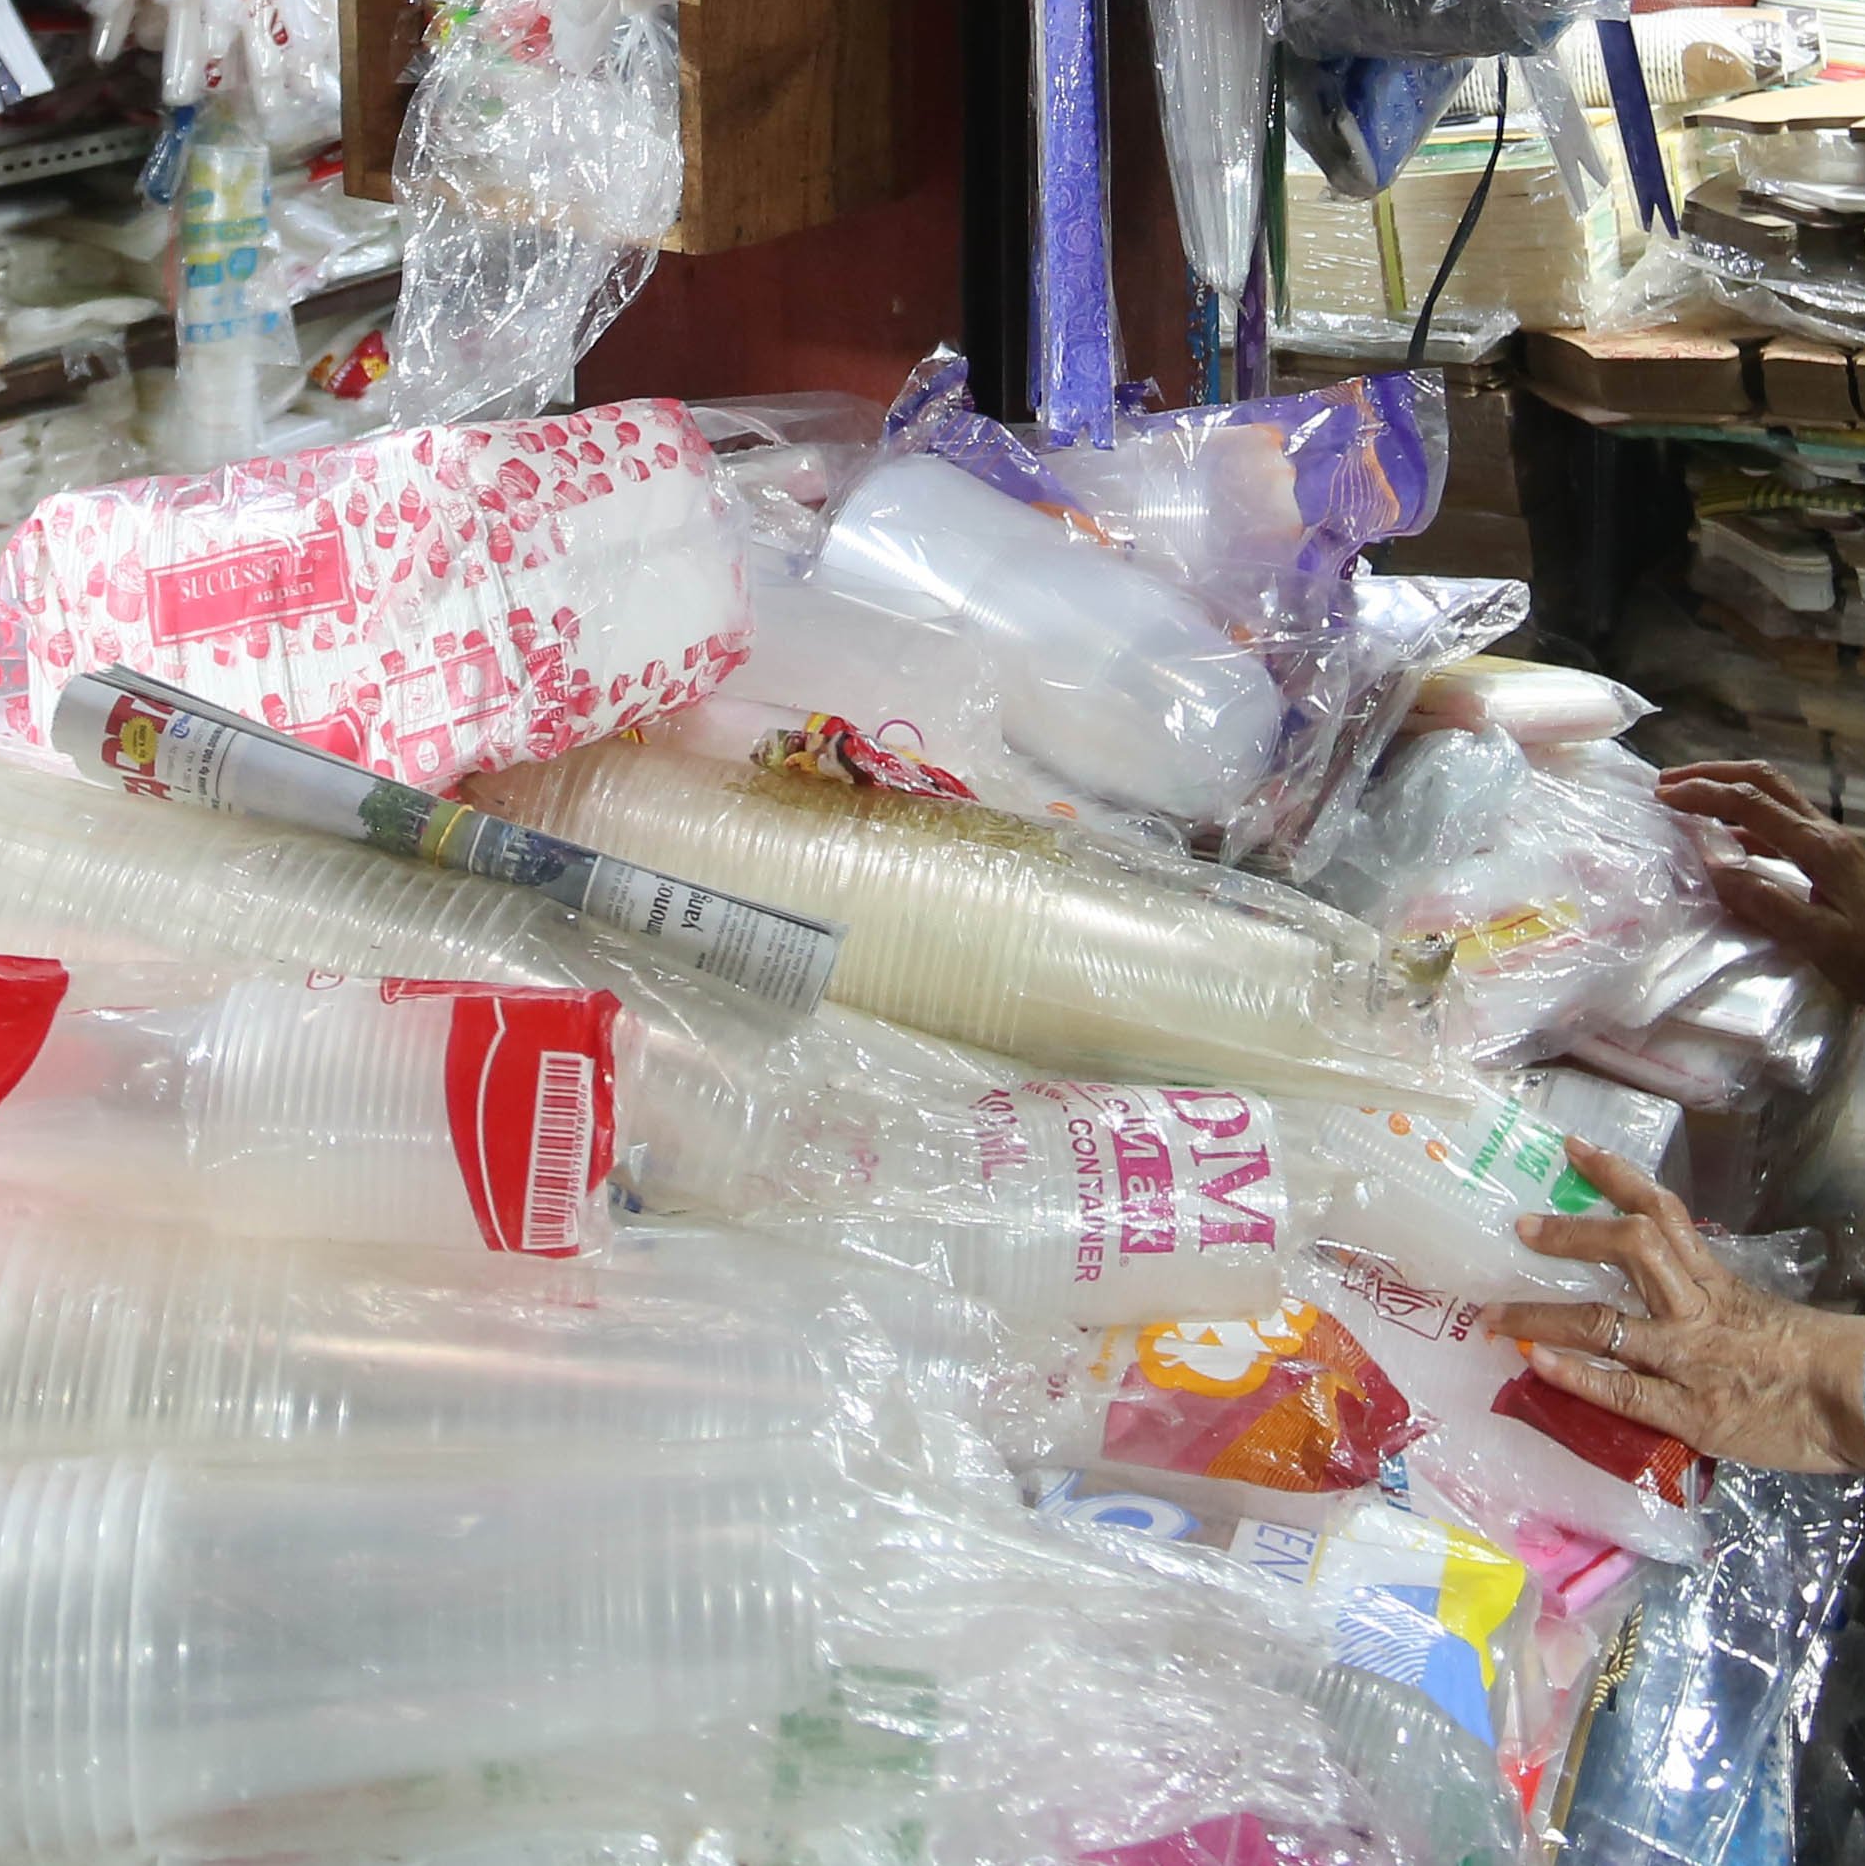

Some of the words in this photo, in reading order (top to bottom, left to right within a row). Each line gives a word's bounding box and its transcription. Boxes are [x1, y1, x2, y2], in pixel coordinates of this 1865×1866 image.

[680, 890, 714, 933] yang
[1068, 1118, 1105, 1284] CONTAINER
[1157, 1088, 1277, 1253] DM
